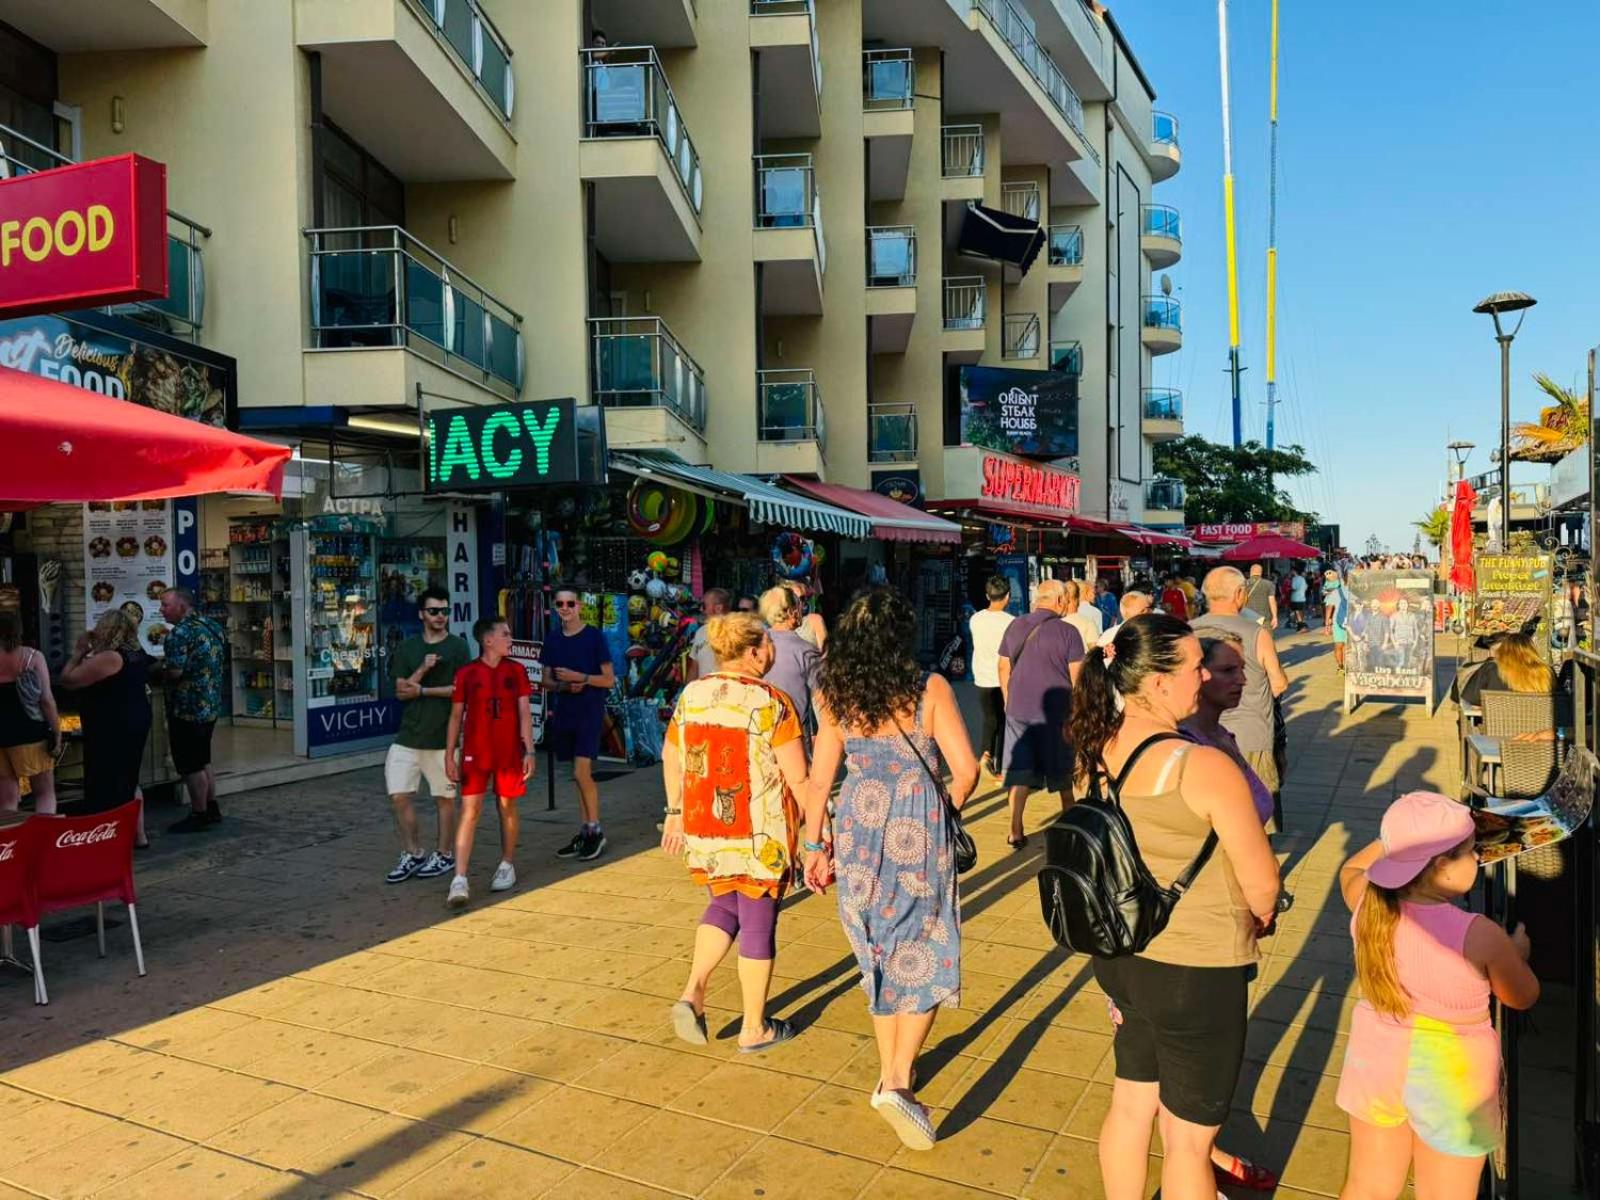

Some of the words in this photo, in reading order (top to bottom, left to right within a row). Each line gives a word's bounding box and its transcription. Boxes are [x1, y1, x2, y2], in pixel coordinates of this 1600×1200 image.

[2, 205, 115, 266] FOOD
[55, 333, 119, 372] Delicious
[999, 392, 1039, 405] ORIENT
[1001, 405, 1036, 417] STEAK
[1001, 417, 1037, 429] HOUSE
[430, 406, 560, 482] ACY
[983, 454, 1081, 508] SUPERMARKET
[1200, 525, 1222, 536] FAST
[1225, 524, 1252, 535] FOOD
[452, 511, 473, 640] HARM
[1480, 558, 1496, 568] THE
[1499, 557, 1526, 569] FUNNY
[320, 706, 387, 732] VICHY
